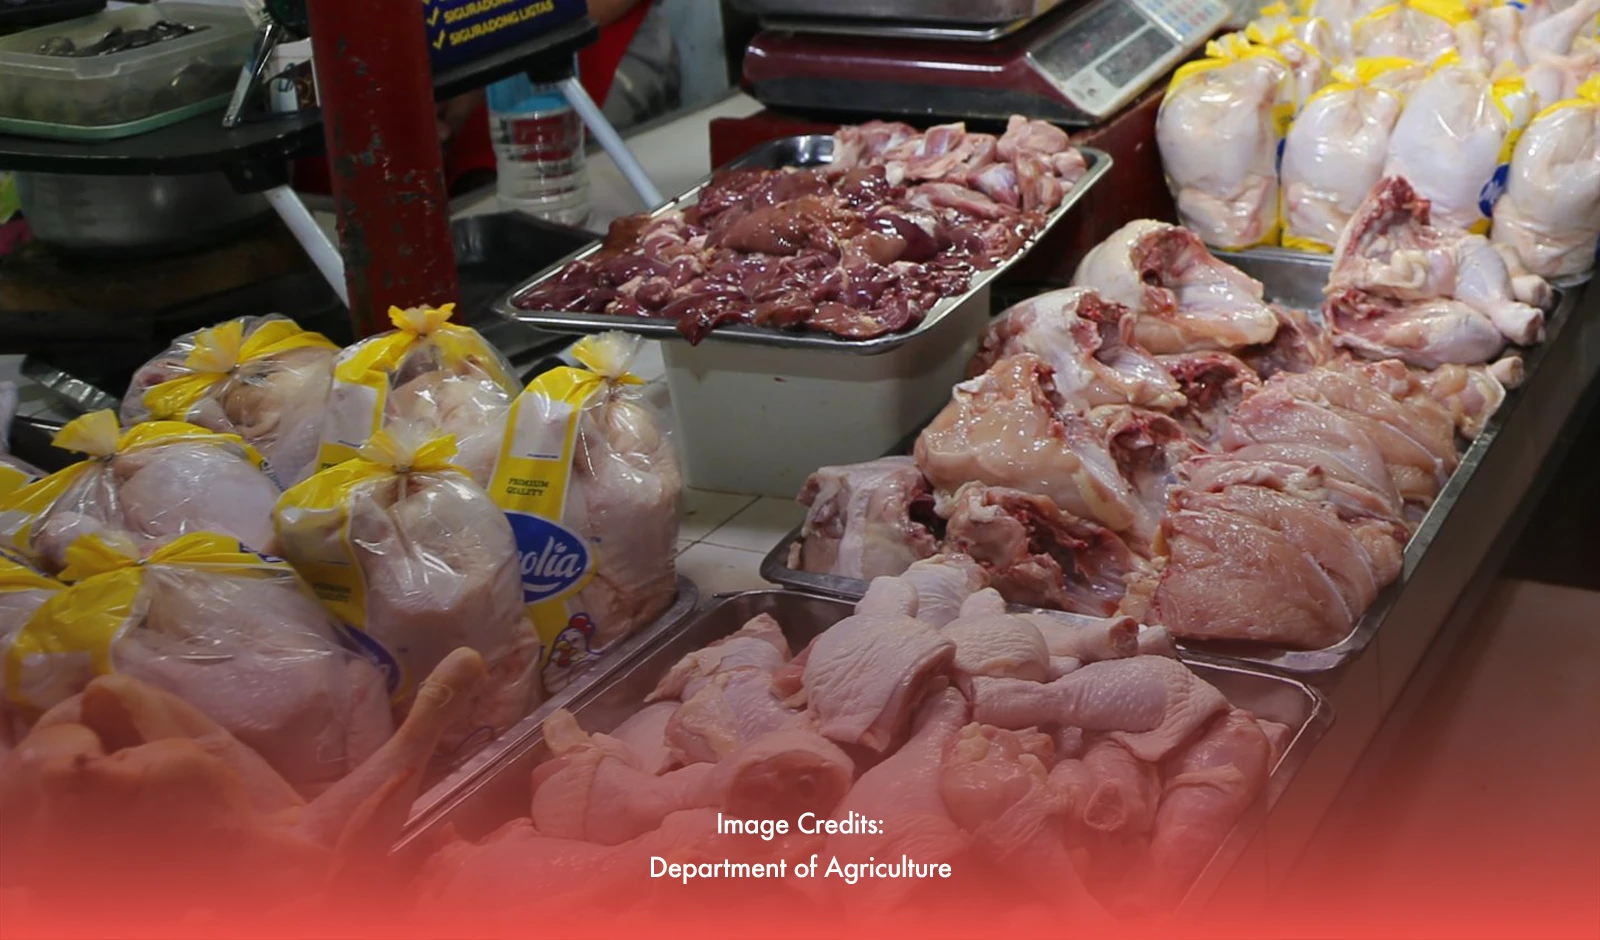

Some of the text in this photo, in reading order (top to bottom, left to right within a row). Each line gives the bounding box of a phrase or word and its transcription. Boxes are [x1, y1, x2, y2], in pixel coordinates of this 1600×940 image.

[444, 0, 516, 24] SIGURADO
[449, 0, 554, 45] SIGURADONG LIGTAS
[505, 486, 544, 496] QUALITY
[508, 478, 549, 488] PREMIUM
[518, 535, 581, 578] olia
